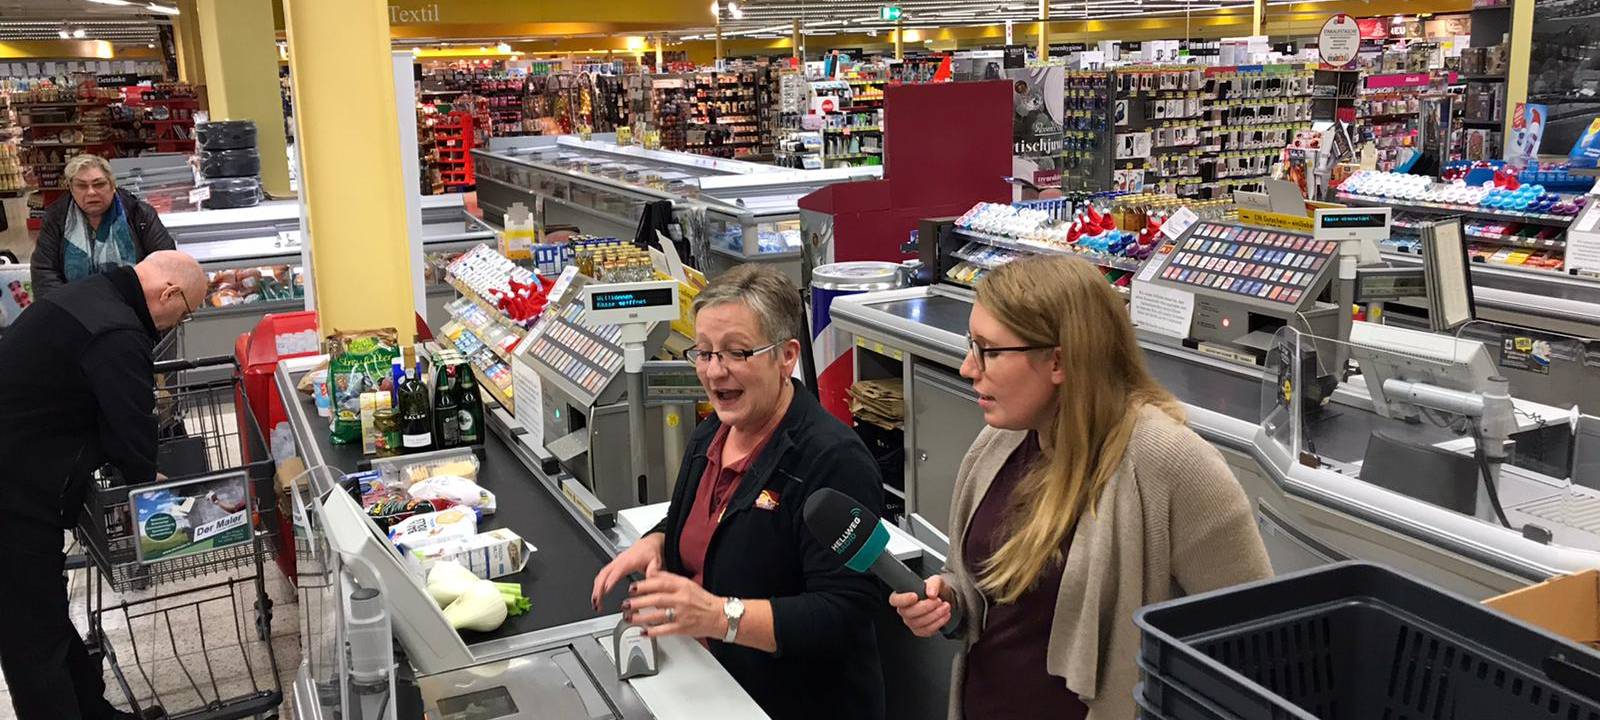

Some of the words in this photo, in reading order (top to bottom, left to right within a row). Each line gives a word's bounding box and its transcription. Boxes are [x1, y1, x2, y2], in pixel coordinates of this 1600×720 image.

[388, 4, 440, 23] Textil
[596, 294, 633, 302] Willkommen
[196, 526, 214, 537] Der
[215, 514, 242, 530] Maler
[830, 516, 861, 551] HELLWEG
[837, 533, 857, 555] RADIO
